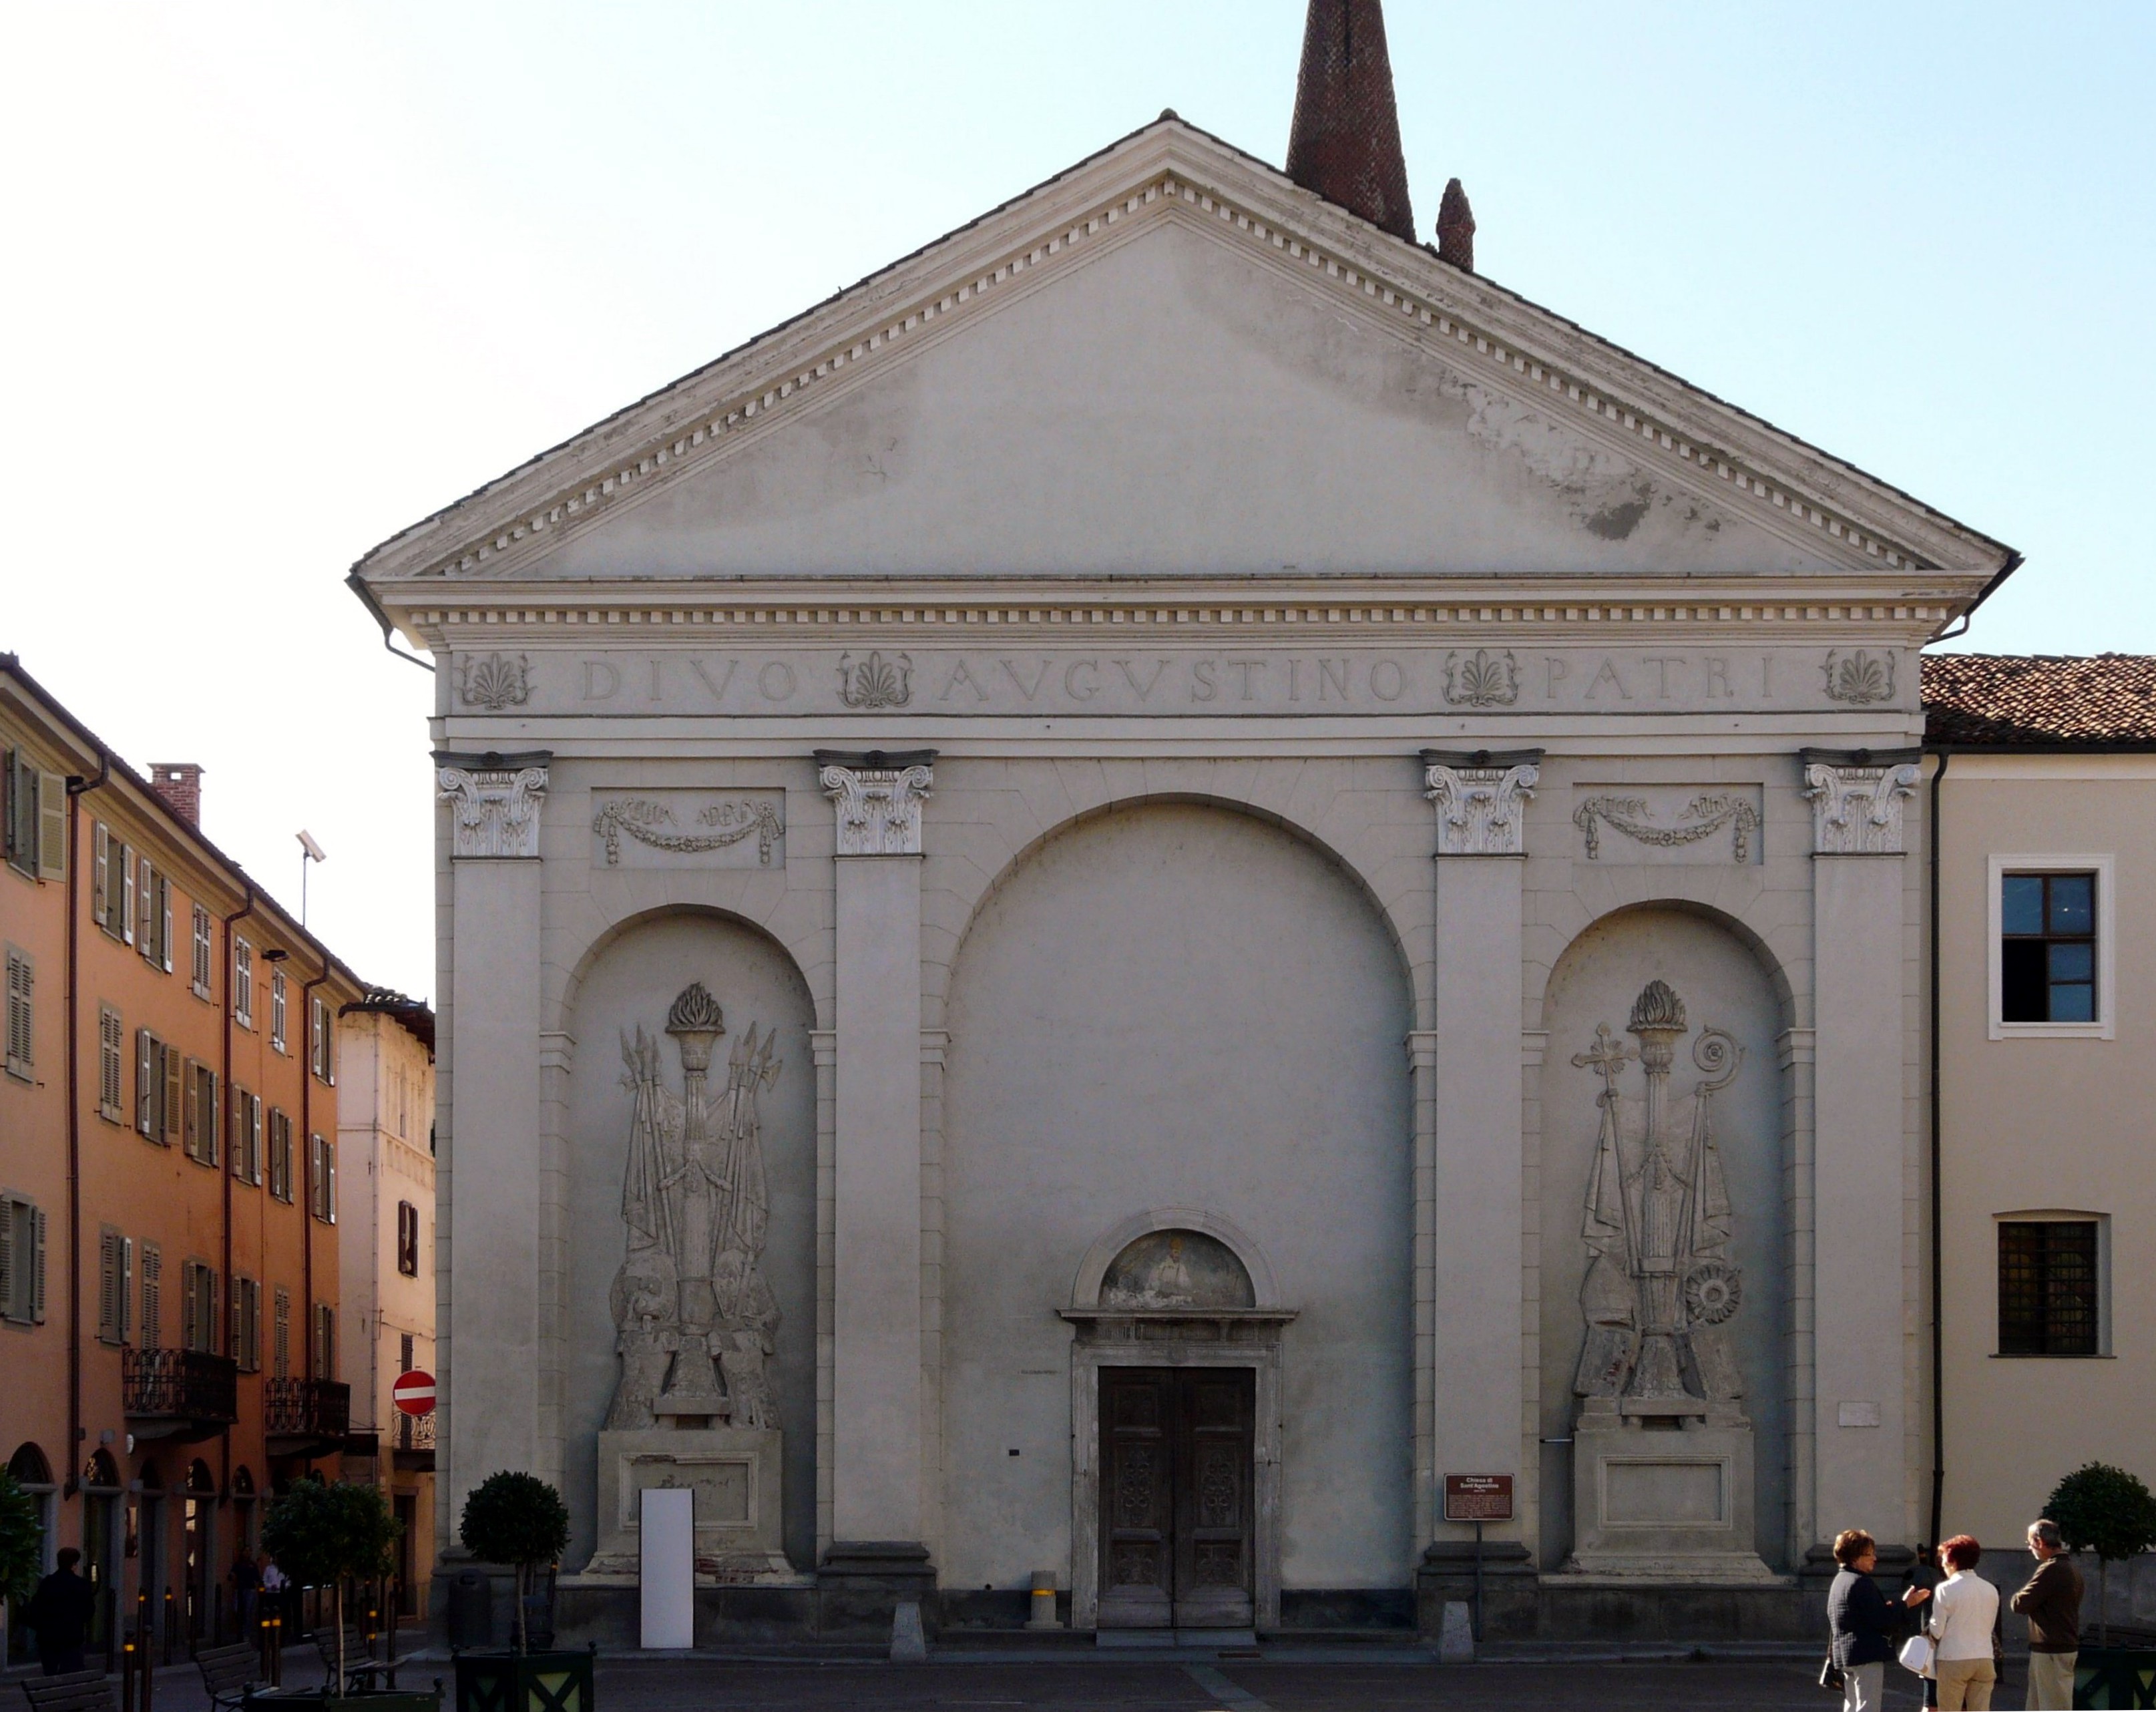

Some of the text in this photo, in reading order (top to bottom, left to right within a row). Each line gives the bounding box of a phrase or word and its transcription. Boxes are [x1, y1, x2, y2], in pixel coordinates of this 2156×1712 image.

[582, 656, 1774, 702] DIVO AVGVSTINO PATRI
